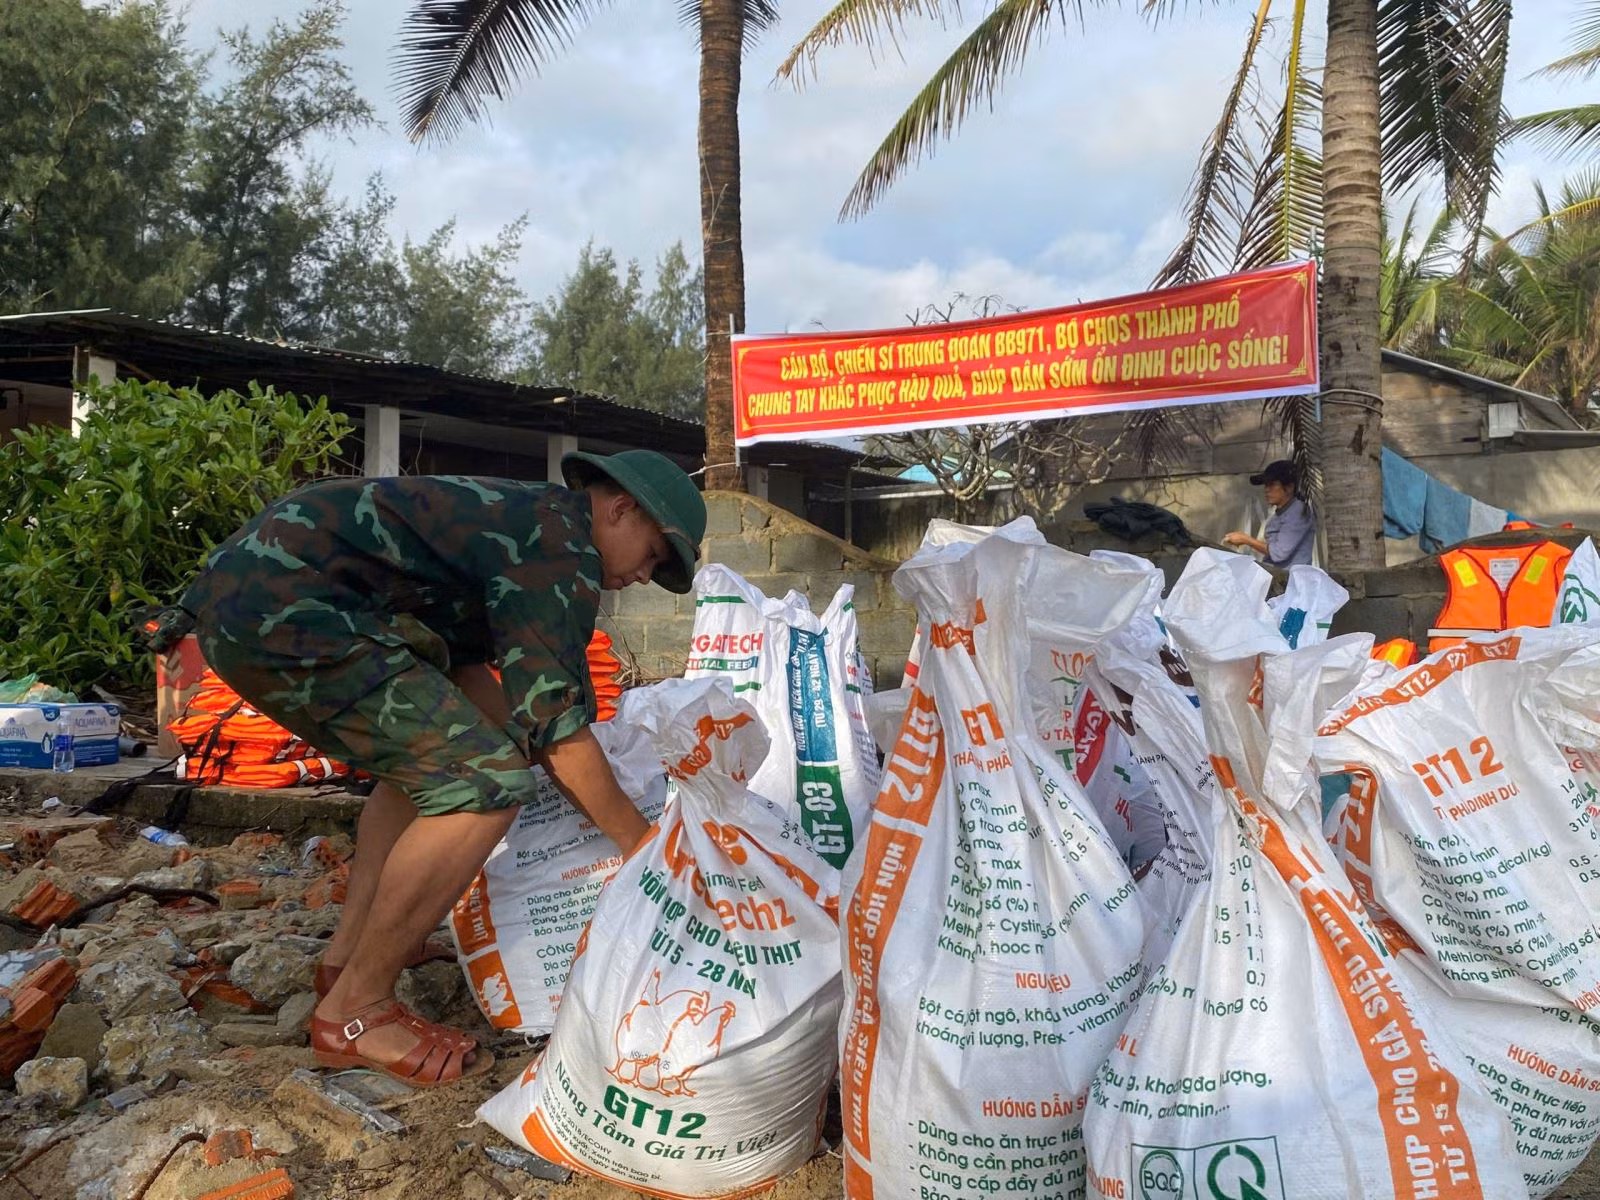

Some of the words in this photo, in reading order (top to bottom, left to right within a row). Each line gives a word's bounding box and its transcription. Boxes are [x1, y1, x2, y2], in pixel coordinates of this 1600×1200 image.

[780, 352, 808, 381] CÁN
[810, 349, 834, 382] BỘ,
[835, 342, 876, 376] CHIẾN
[898, 339, 944, 369] TRUNG
[1135, 303, 1197, 340] THÀNH
[1201, 288, 1242, 331] PHỐ
[748, 391, 791, 418] CHUNG
[794, 389, 816, 414] TAY
[819, 374, 855, 412] KHẮC
[858, 381, 896, 411] PHỤC
[898, 373, 930, 408] HẬU
[971, 364, 1006, 396] GIÚP
[1011, 360, 1046, 393] DÂN
[1049, 354, 1087, 389] SỚM
[1092, 346, 1117, 384] ỔN
[1121, 349, 1166, 386] ĐỊNH
[1170, 339, 1222, 379] CUỘC
[1227, 327, 1289, 369] SỐNG!
[987, 747, 1013, 774] PHẦ
[801, 781, 847, 855] GT-03
[991, 804, 1017, 817] min
[979, 817, 1004, 834] trao
[1438, 834, 1460, 851] (%)
[875, 842, 906, 888] HỖN
[992, 859, 1022, 870] max
[1443, 852, 1468, 868] thô
[1569, 854, 1591, 868] 0.5
[996, 878, 1022, 891] min
[1441, 870, 1484, 887] lượng
[553, 889, 572, 900] cho
[985, 895, 1001, 910] số
[1006, 898, 1029, 913] (%)
[1455, 889, 1479, 903] (%)
[529, 903, 560, 917] Không
[862, 892, 888, 940] HỢP
[1422, 894, 1443, 908] Ca
[1464, 908, 1491, 920] min
[532, 915, 558, 927] Cung
[1425, 913, 1433, 924] P
[1437, 913, 1466, 934] tổng
[1485, 924, 1510, 938] (%)
[685, 915, 721, 948] CHO
[760, 940, 803, 966] THỊT
[990, 940, 1031, 954] hooc
[1506, 939, 1524, 955] số
[1527, 935, 1548, 952] (%)
[1578, 928, 1594, 947] số
[536, 942, 576, 959] CÔNG
[697, 959, 726, 983] 28
[1442, 967, 1490, 983] Kháng
[1345, 954, 1390, 1020] SIÊU
[918, 996, 941, 1016] Bột
[985, 1009, 1020, 1026] ngô,
[1062, 992, 1110, 1018] tương,
[1250, 996, 1268, 1013] có
[979, 1030, 1029, 1048] lượng,
[1370, 1020, 1412, 1062] GÀ
[1507, 1043, 1559, 1079] HƯỚNG
[1558, 1067, 1590, 1091] DẪN
[1194, 1076, 1217, 1092] đa
[1478, 1061, 1508, 1085] cho
[1511, 1077, 1531, 1097] ăn
[1534, 1088, 1561, 1108] trực
[1562, 1098, 1587, 1115] tiếp
[982, 1098, 1037, 1119] HƯỚNG
[1042, 1093, 1073, 1119] DẪN
[1391, 1067, 1421, 1126] CHO
[603, 1084, 707, 1139] GT12
[1511, 1100, 1540, 1120] pha
[1543, 1111, 1567, 1128] trộn
[592, 1109, 636, 1148] Tầm
[644, 1140, 686, 1160] Giá
[694, 1145, 728, 1162] Trị
[736, 1130, 778, 1152] Việt
[918, 1120, 958, 1146] Dùng
[962, 1134, 994, 1149] cho
[999, 1134, 1021, 1149] ăn
[1026, 1134, 1057, 1151] trực
[1529, 1125, 1548, 1141] đủ
[1548, 1132, 1577, 1145] nước
[918, 1142, 968, 1170] Không
[973, 1152, 1006, 1171] cần
[1011, 1155, 1044, 1172] pha
[1048, 1148, 1078, 1166] trộn
[1516, 1140, 1539, 1158] khô
[1405, 1134, 1440, 1200] HỢP
[1443, 1146, 1471, 1186] TỪ
[919, 1164, 962, 1190] Cung
[967, 1176, 1000, 1194] cấp
[1005, 1173, 1038, 1191] đầy
[1042, 1169, 1064, 1187] đủ
[1142, 1171, 1180, 1192] BQC
